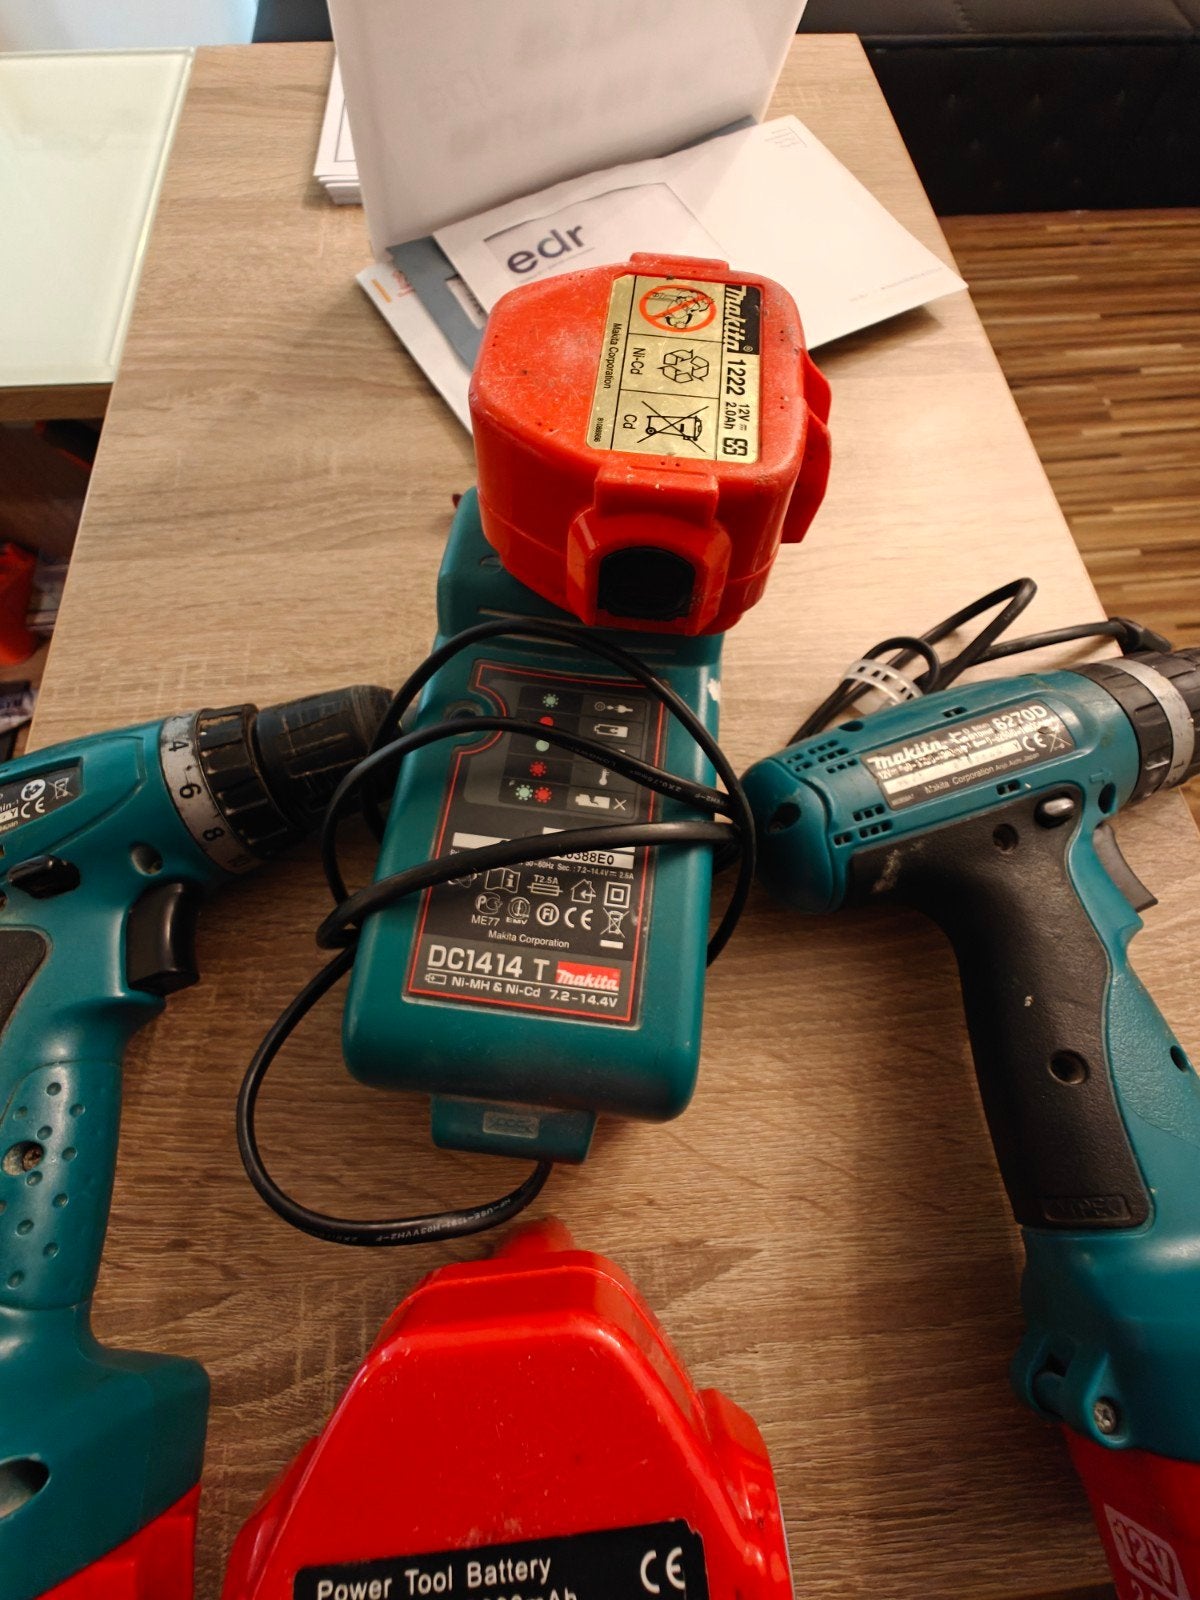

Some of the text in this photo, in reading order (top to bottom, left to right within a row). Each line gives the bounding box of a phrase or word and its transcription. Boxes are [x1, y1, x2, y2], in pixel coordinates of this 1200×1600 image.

[507, 224, 584, 274] edr
[603, 323, 622, 389] Makita Corporation
[630, 347, 651, 375] Ni-Cd
[726, 359, 747, 395] 1222
[623, 414, 638, 430] Cd
[724, 401, 737, 430] 2.0Ah
[738, 404, 750, 422] 12V
[992, 705, 1048, 731] 6270D
[952, 767, 994, 785] Corporation
[168, 740, 189, 752] 4
[179, 783, 202, 799] 6
[202, 827, 225, 842] 8
[534, 874, 559, 885] T2.5A
[471, 914, 500, 927] ME77
[488, 929, 570, 949] Makita Corporation
[427, 944, 550, 981] DC1414 T
[451, 976, 491, 993] Ni-MH
[492, 982, 502, 993] &
[505, 983, 541, 998] Ni-Cd
[1112, 1519, 1179, 1599] 12V
[317, 1577, 392, 1600] Power
[404, 1565, 453, 1596] Tool
[467, 1557, 551, 1588] Battery
